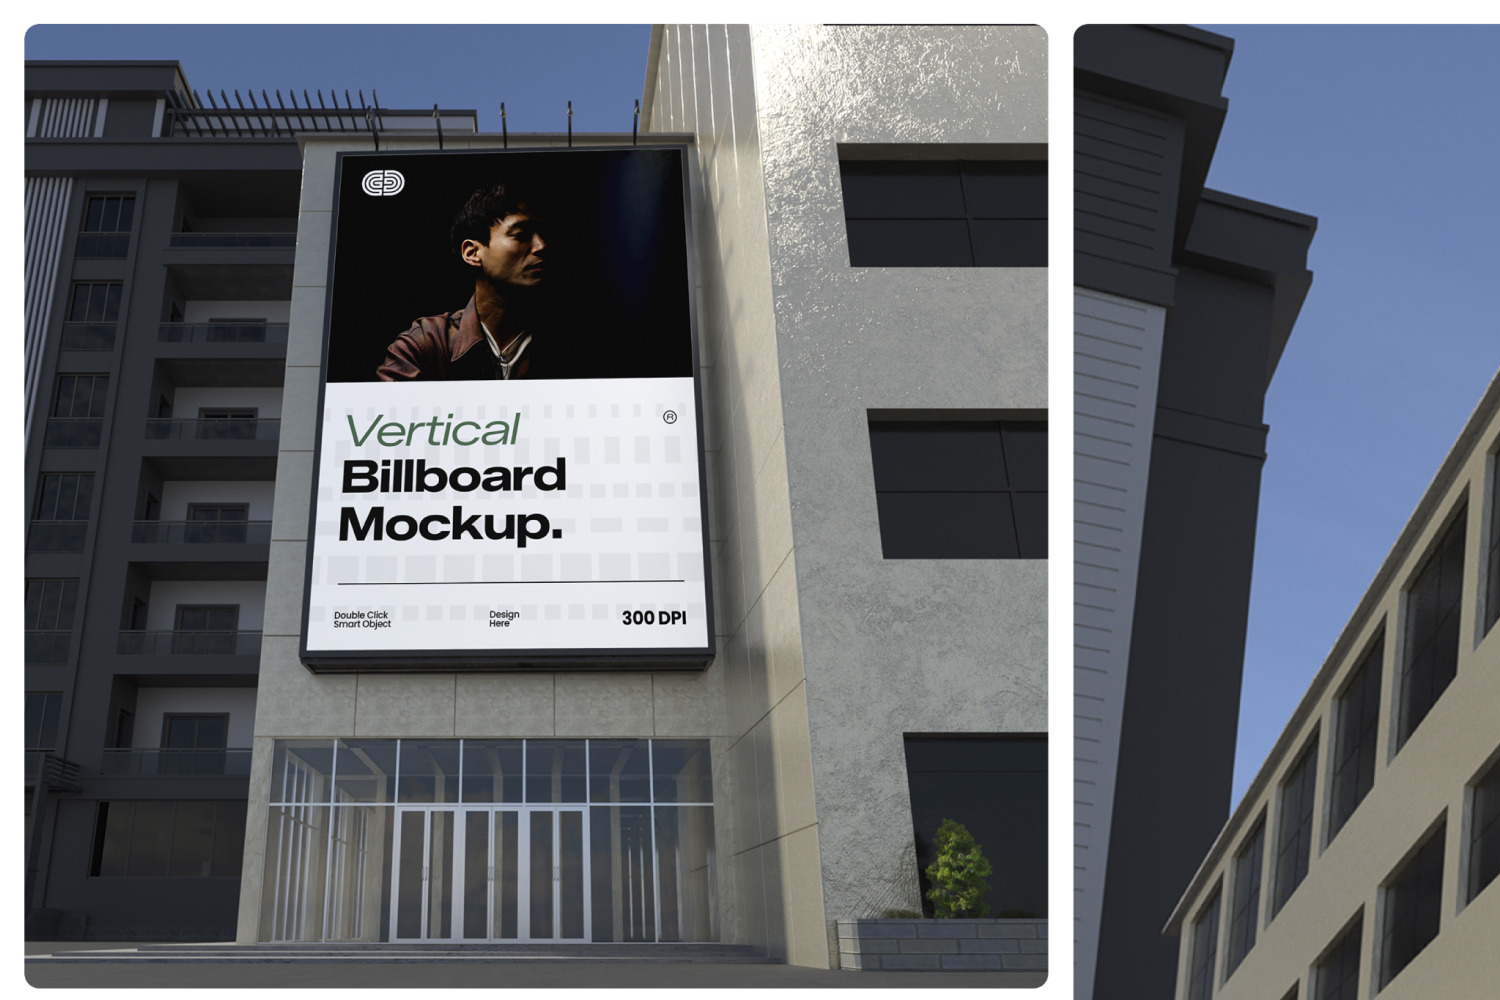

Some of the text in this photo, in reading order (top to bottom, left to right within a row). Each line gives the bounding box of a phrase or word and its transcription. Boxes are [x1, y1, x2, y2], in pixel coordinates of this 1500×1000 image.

[346, 412, 521, 448] Vertical
[341, 456, 567, 494] Billboard
[338, 505, 563, 549] Mockup.
[334, 610, 389, 620] Double Click
[489, 610, 520, 621] Design
[622, 609, 687, 626] 300 DPI
[333, 619, 392, 631] Smart Object
[489, 619, 511, 628] Here
